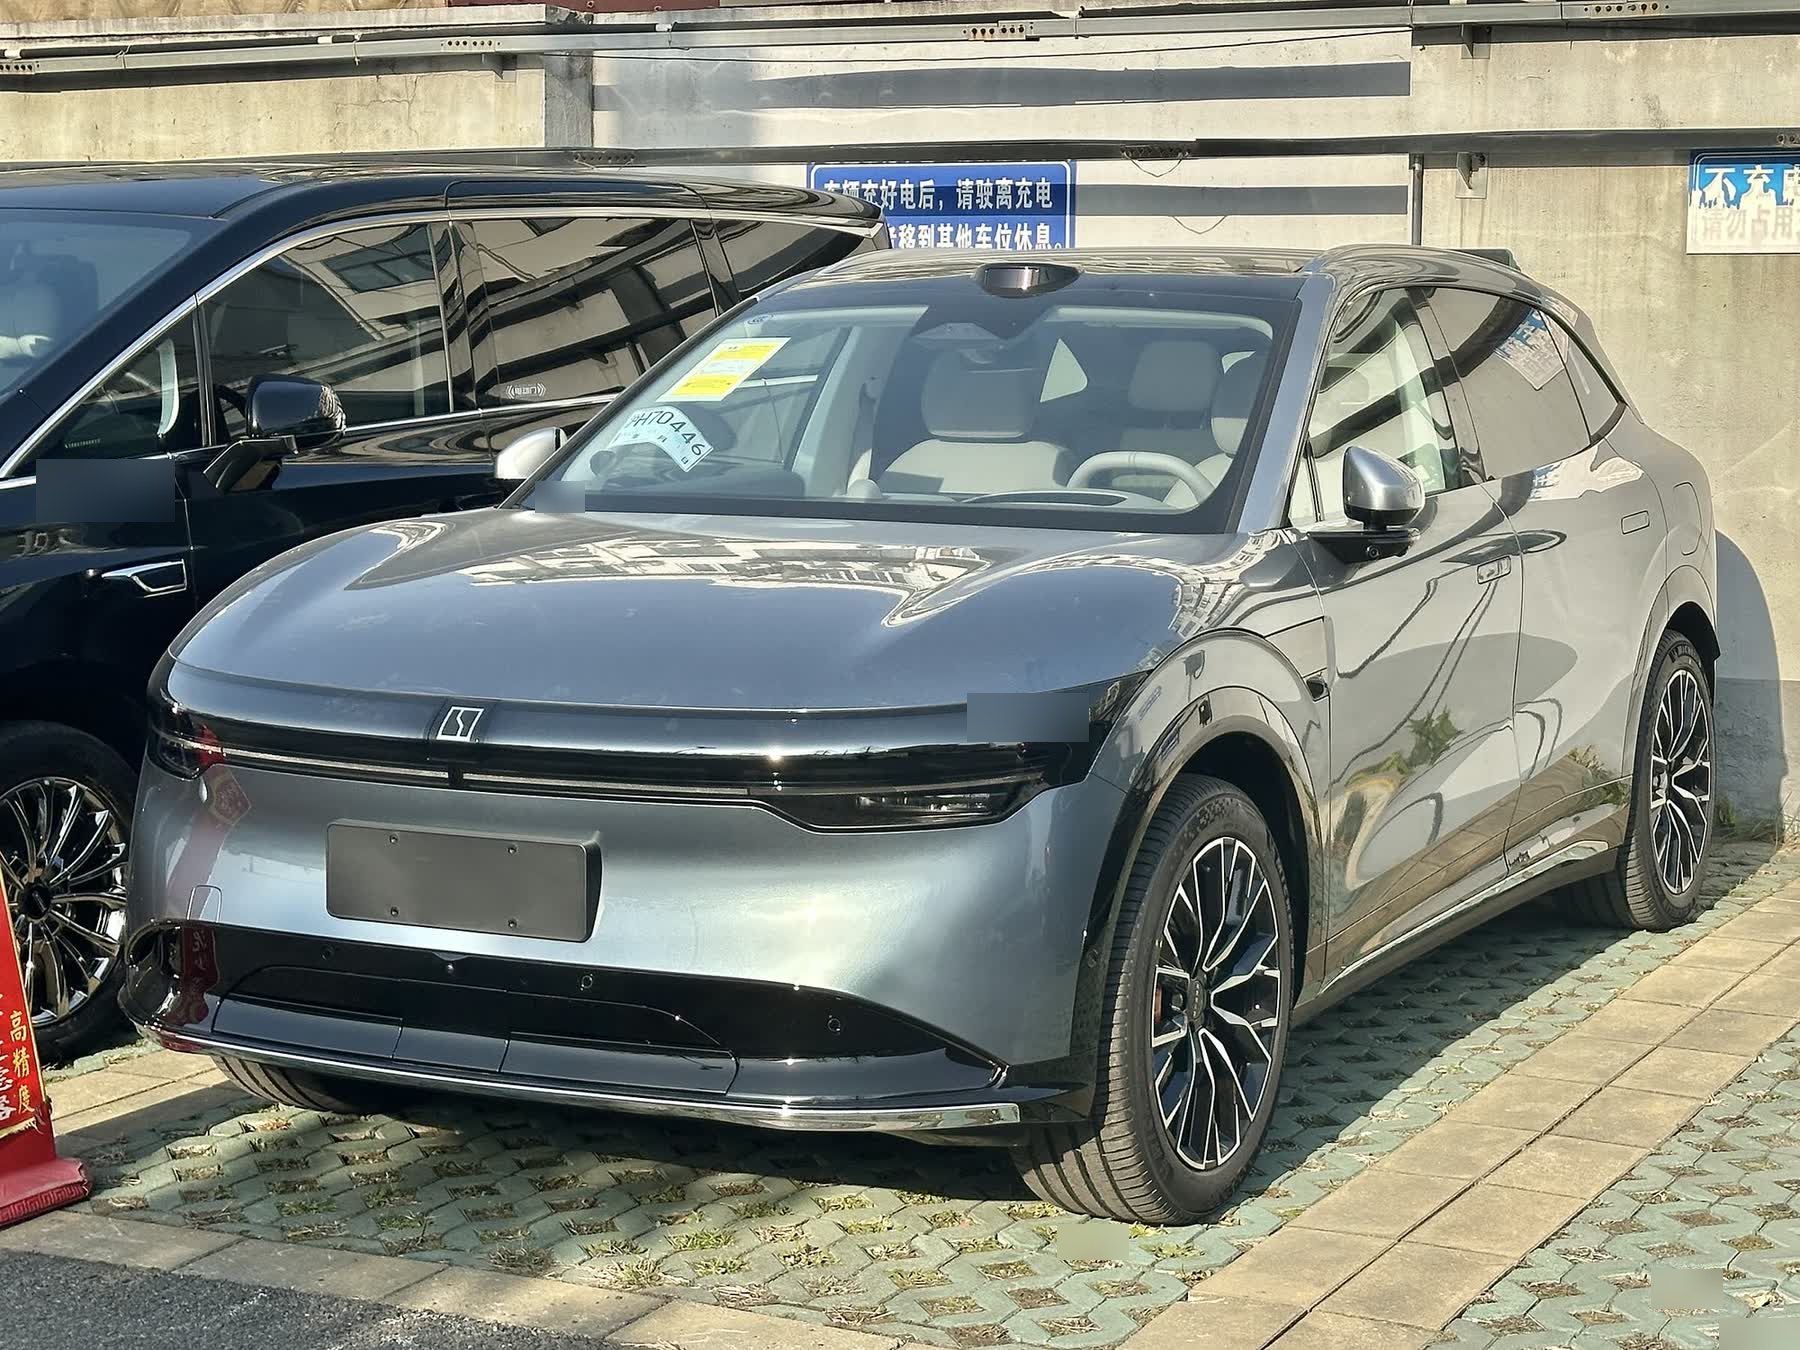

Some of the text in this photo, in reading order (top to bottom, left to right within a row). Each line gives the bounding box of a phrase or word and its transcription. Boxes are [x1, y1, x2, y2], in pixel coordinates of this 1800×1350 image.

[1702, 208, 1800, 240] 请勿占用
[9, 1010, 36, 1114] 高精度
